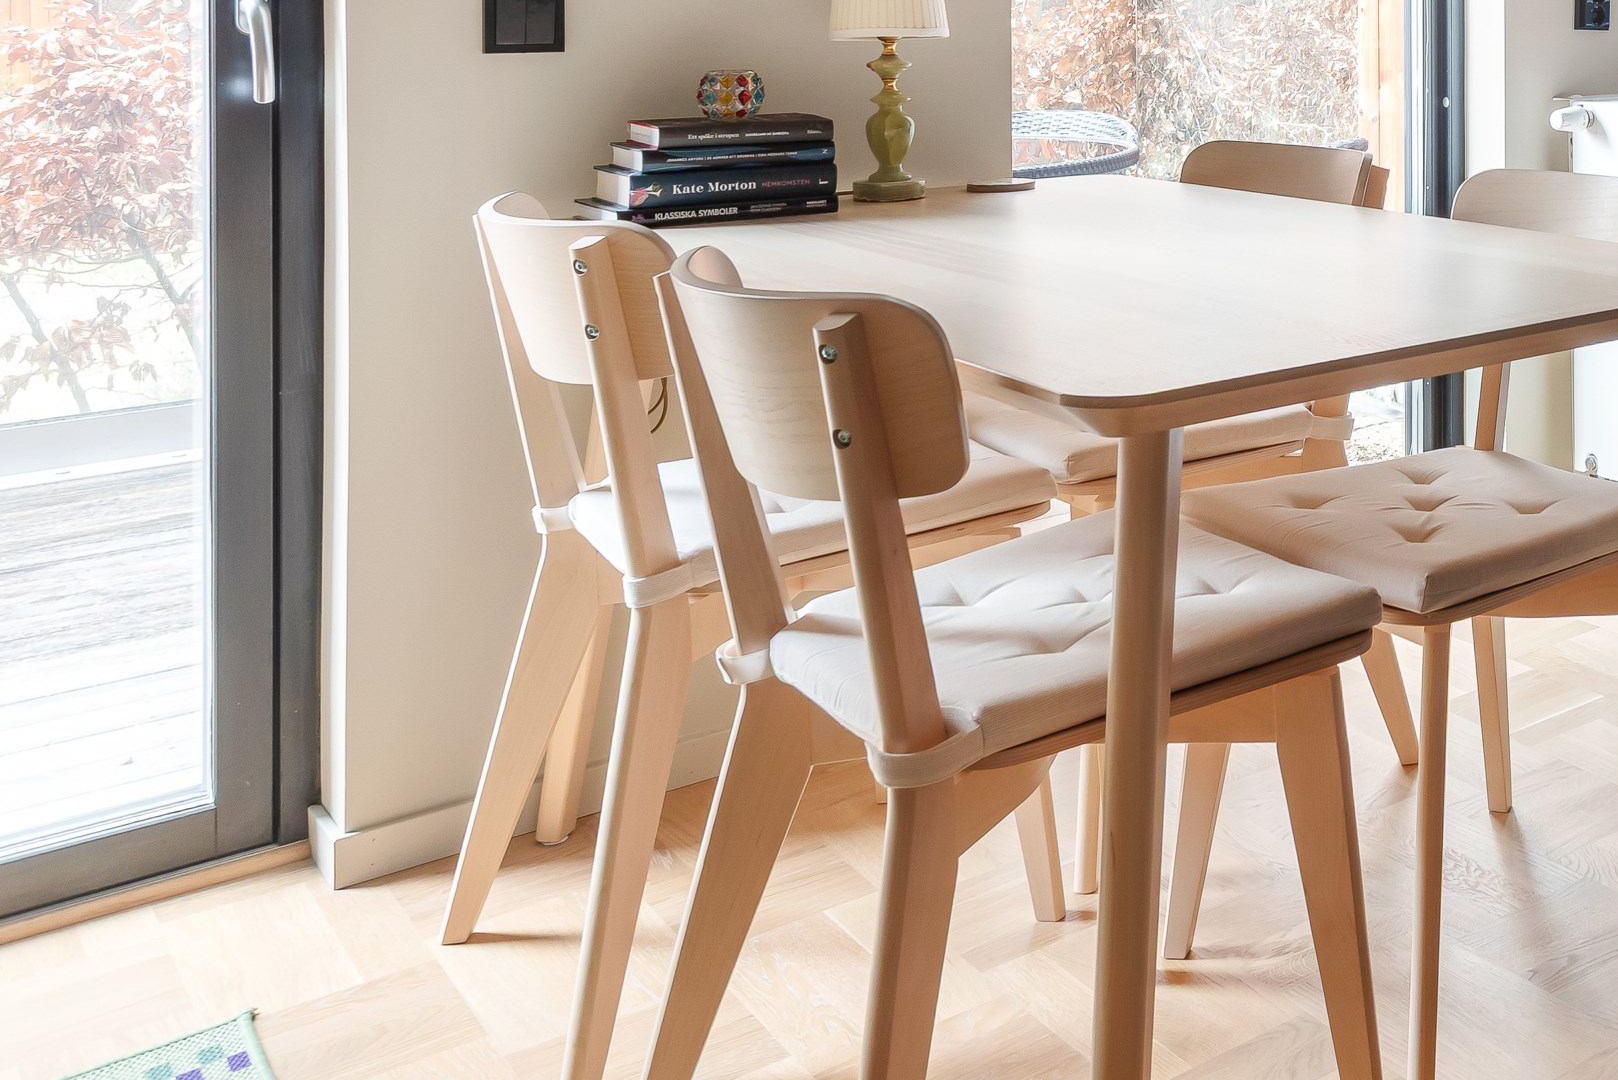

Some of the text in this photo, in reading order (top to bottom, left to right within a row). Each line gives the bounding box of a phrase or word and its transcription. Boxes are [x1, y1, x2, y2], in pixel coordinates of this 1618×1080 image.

[672, 178, 811, 195] Kate Morton HEMKOMSTEN
[655, 210, 697, 221] KLASSISKA
[698, 206, 738, 218] SYMBOLER
